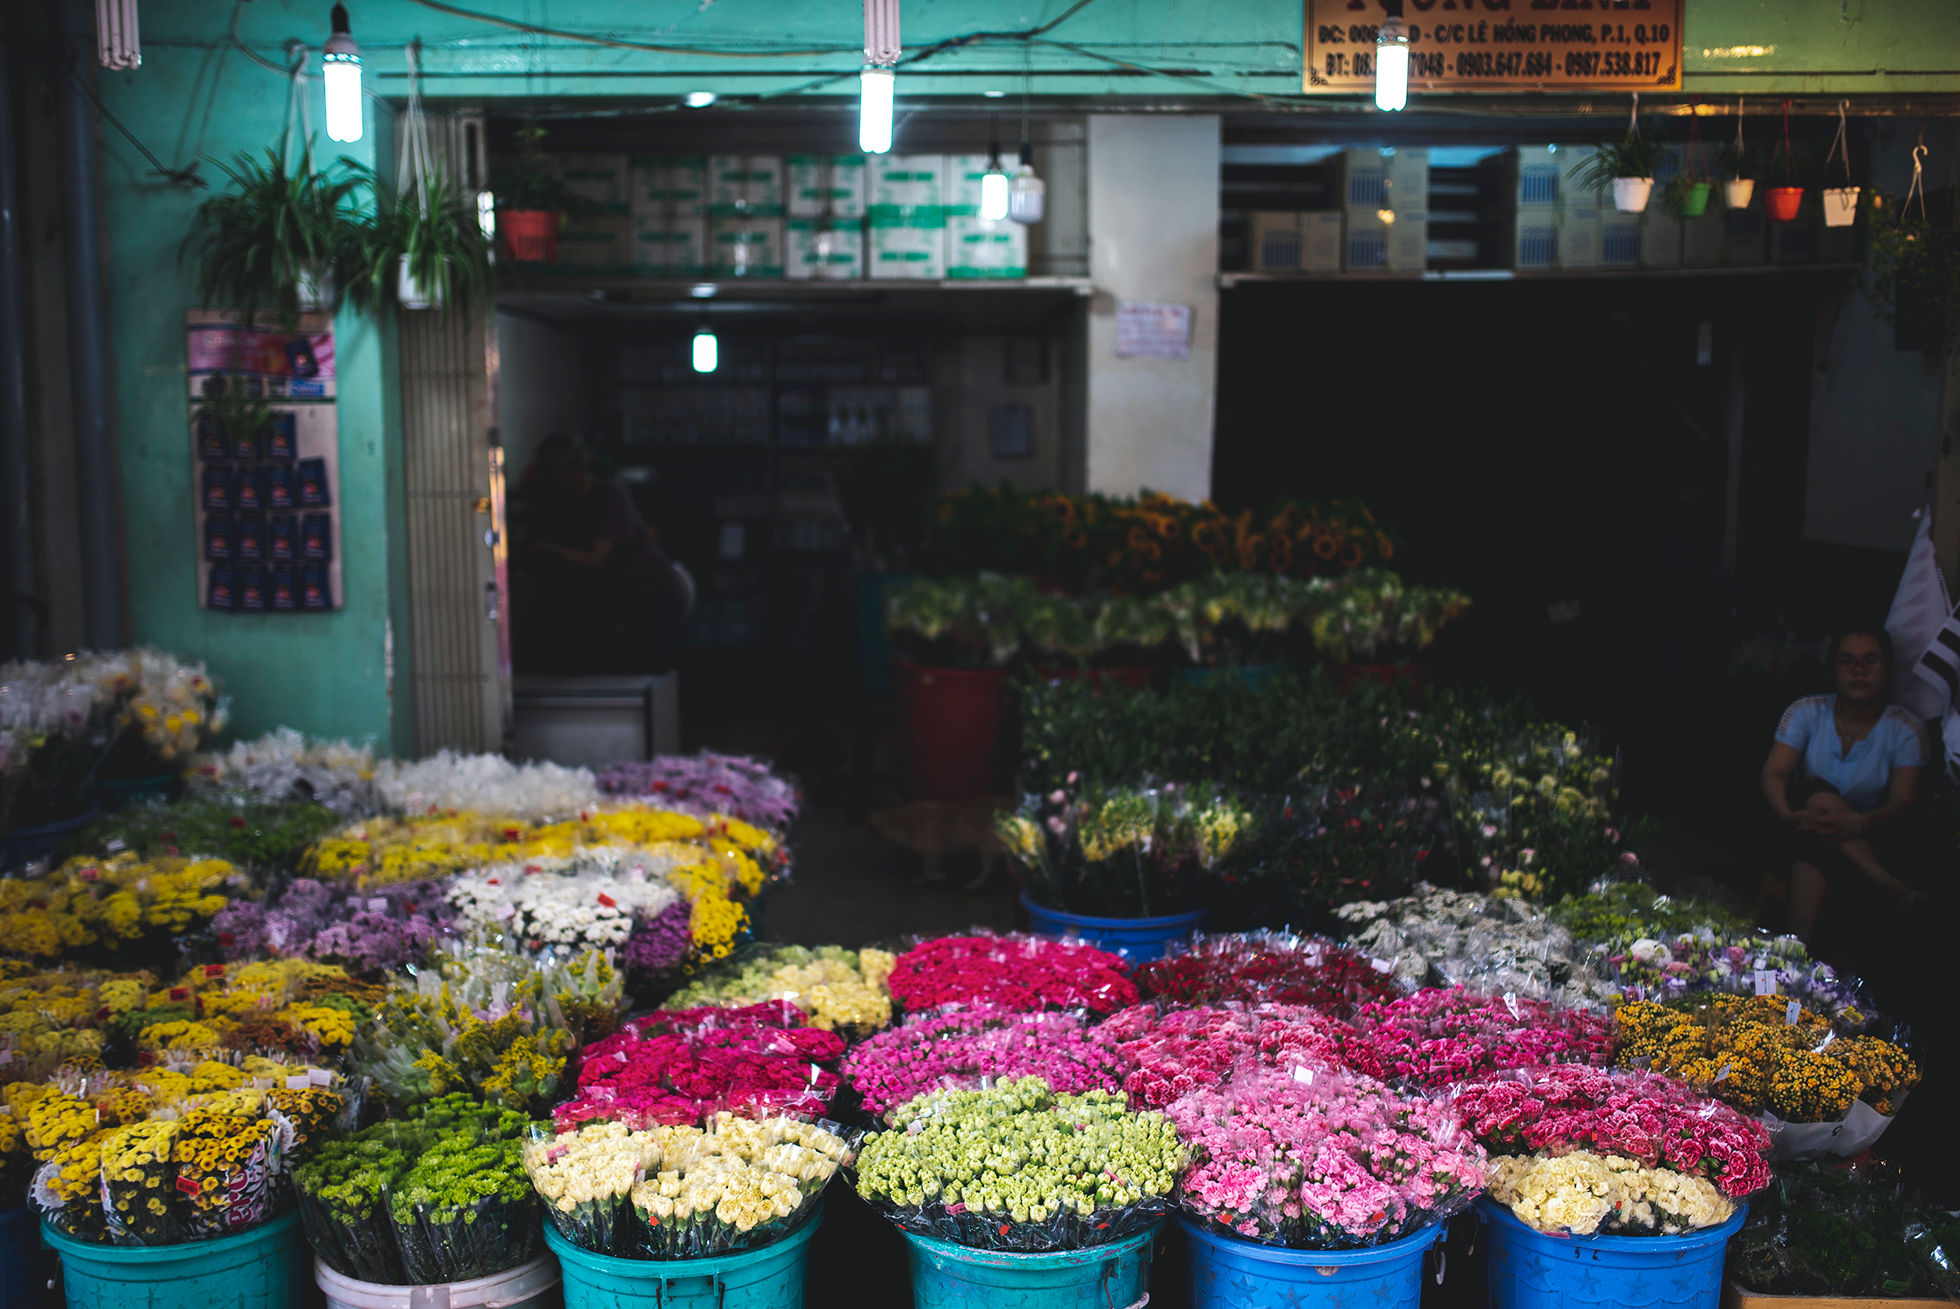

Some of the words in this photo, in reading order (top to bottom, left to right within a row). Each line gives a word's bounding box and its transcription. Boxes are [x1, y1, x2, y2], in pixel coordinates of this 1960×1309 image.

[1434, 23, 1465, 43] C/C
[1468, 19, 1489, 43] LÊ
[1540, 24, 1598, 46] PHONG,
[1601, 24, 1631, 46] P.1,
[1634, 24, 1670, 45] Q.10
